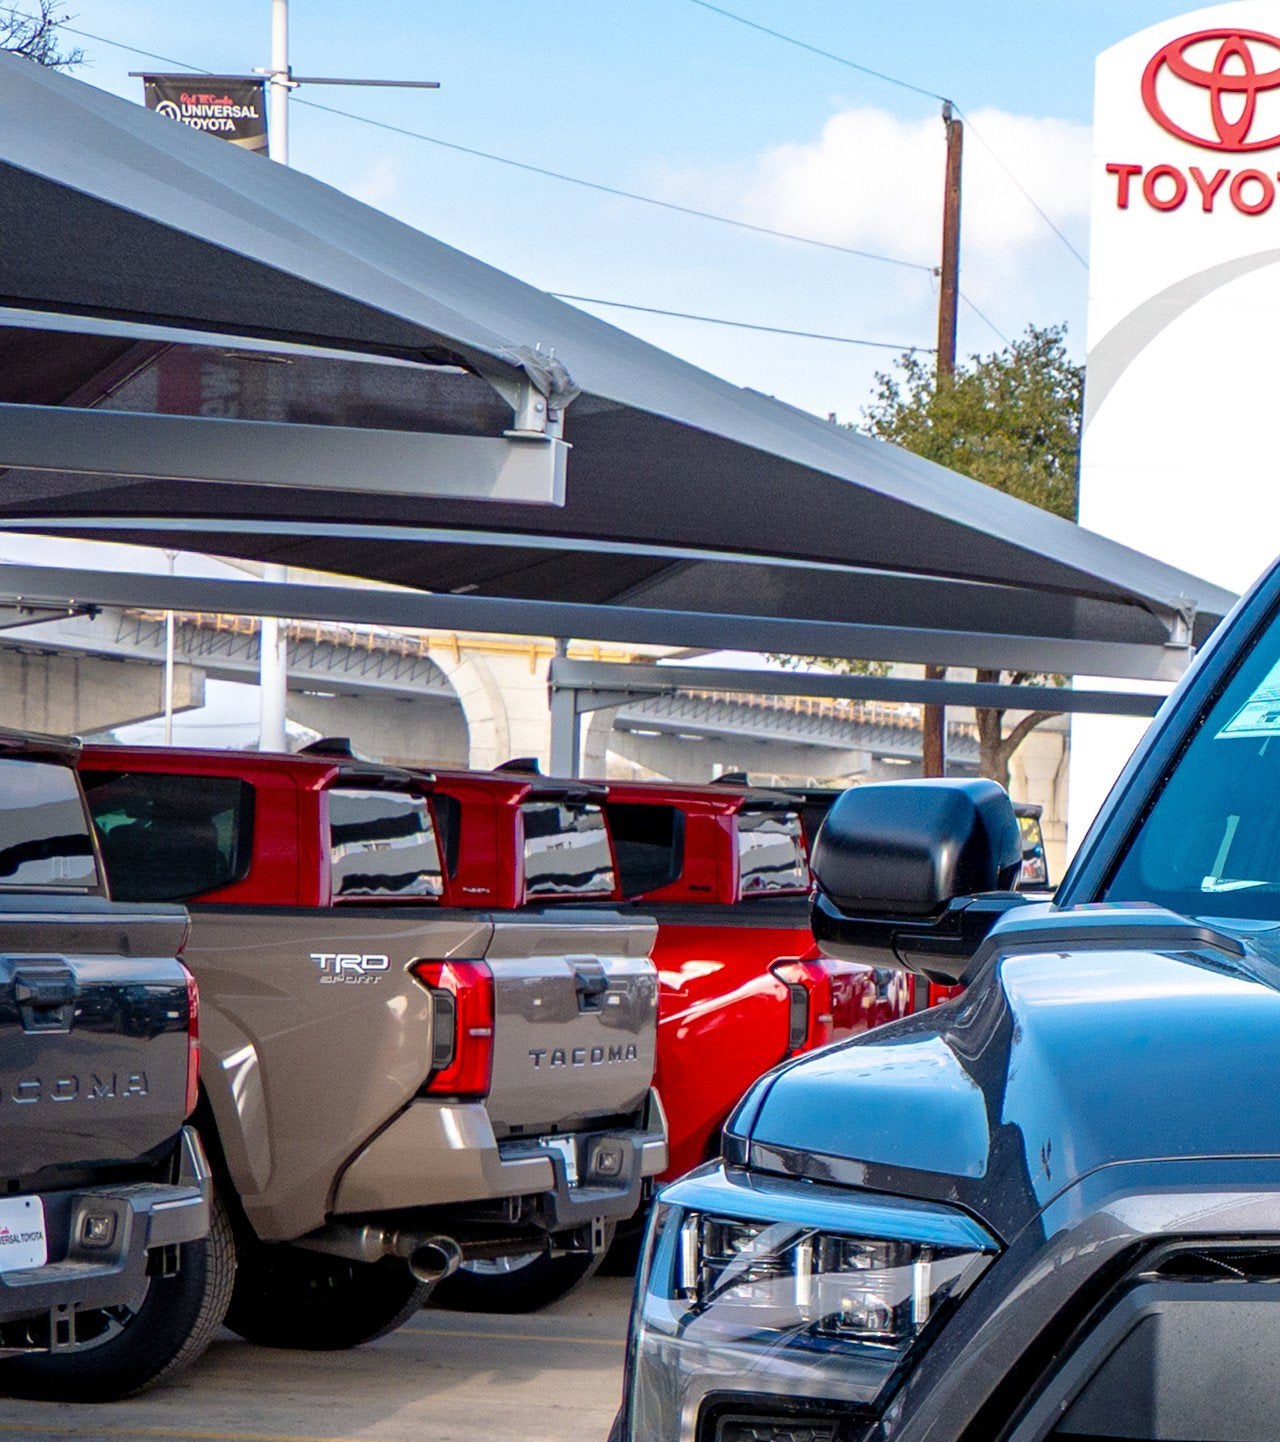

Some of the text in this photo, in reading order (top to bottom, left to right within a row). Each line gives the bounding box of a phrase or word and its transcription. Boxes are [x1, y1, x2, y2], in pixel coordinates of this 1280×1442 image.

[181, 104, 260, 118] UNIVERSAL
[181, 117, 237, 131] TOYOTA
[309, 953, 391, 975] TRD
[319, 975, 383, 985] SPORT
[528, 1043, 638, 1070] TACOMA
[10, 1071, 149, 1105] COMA
